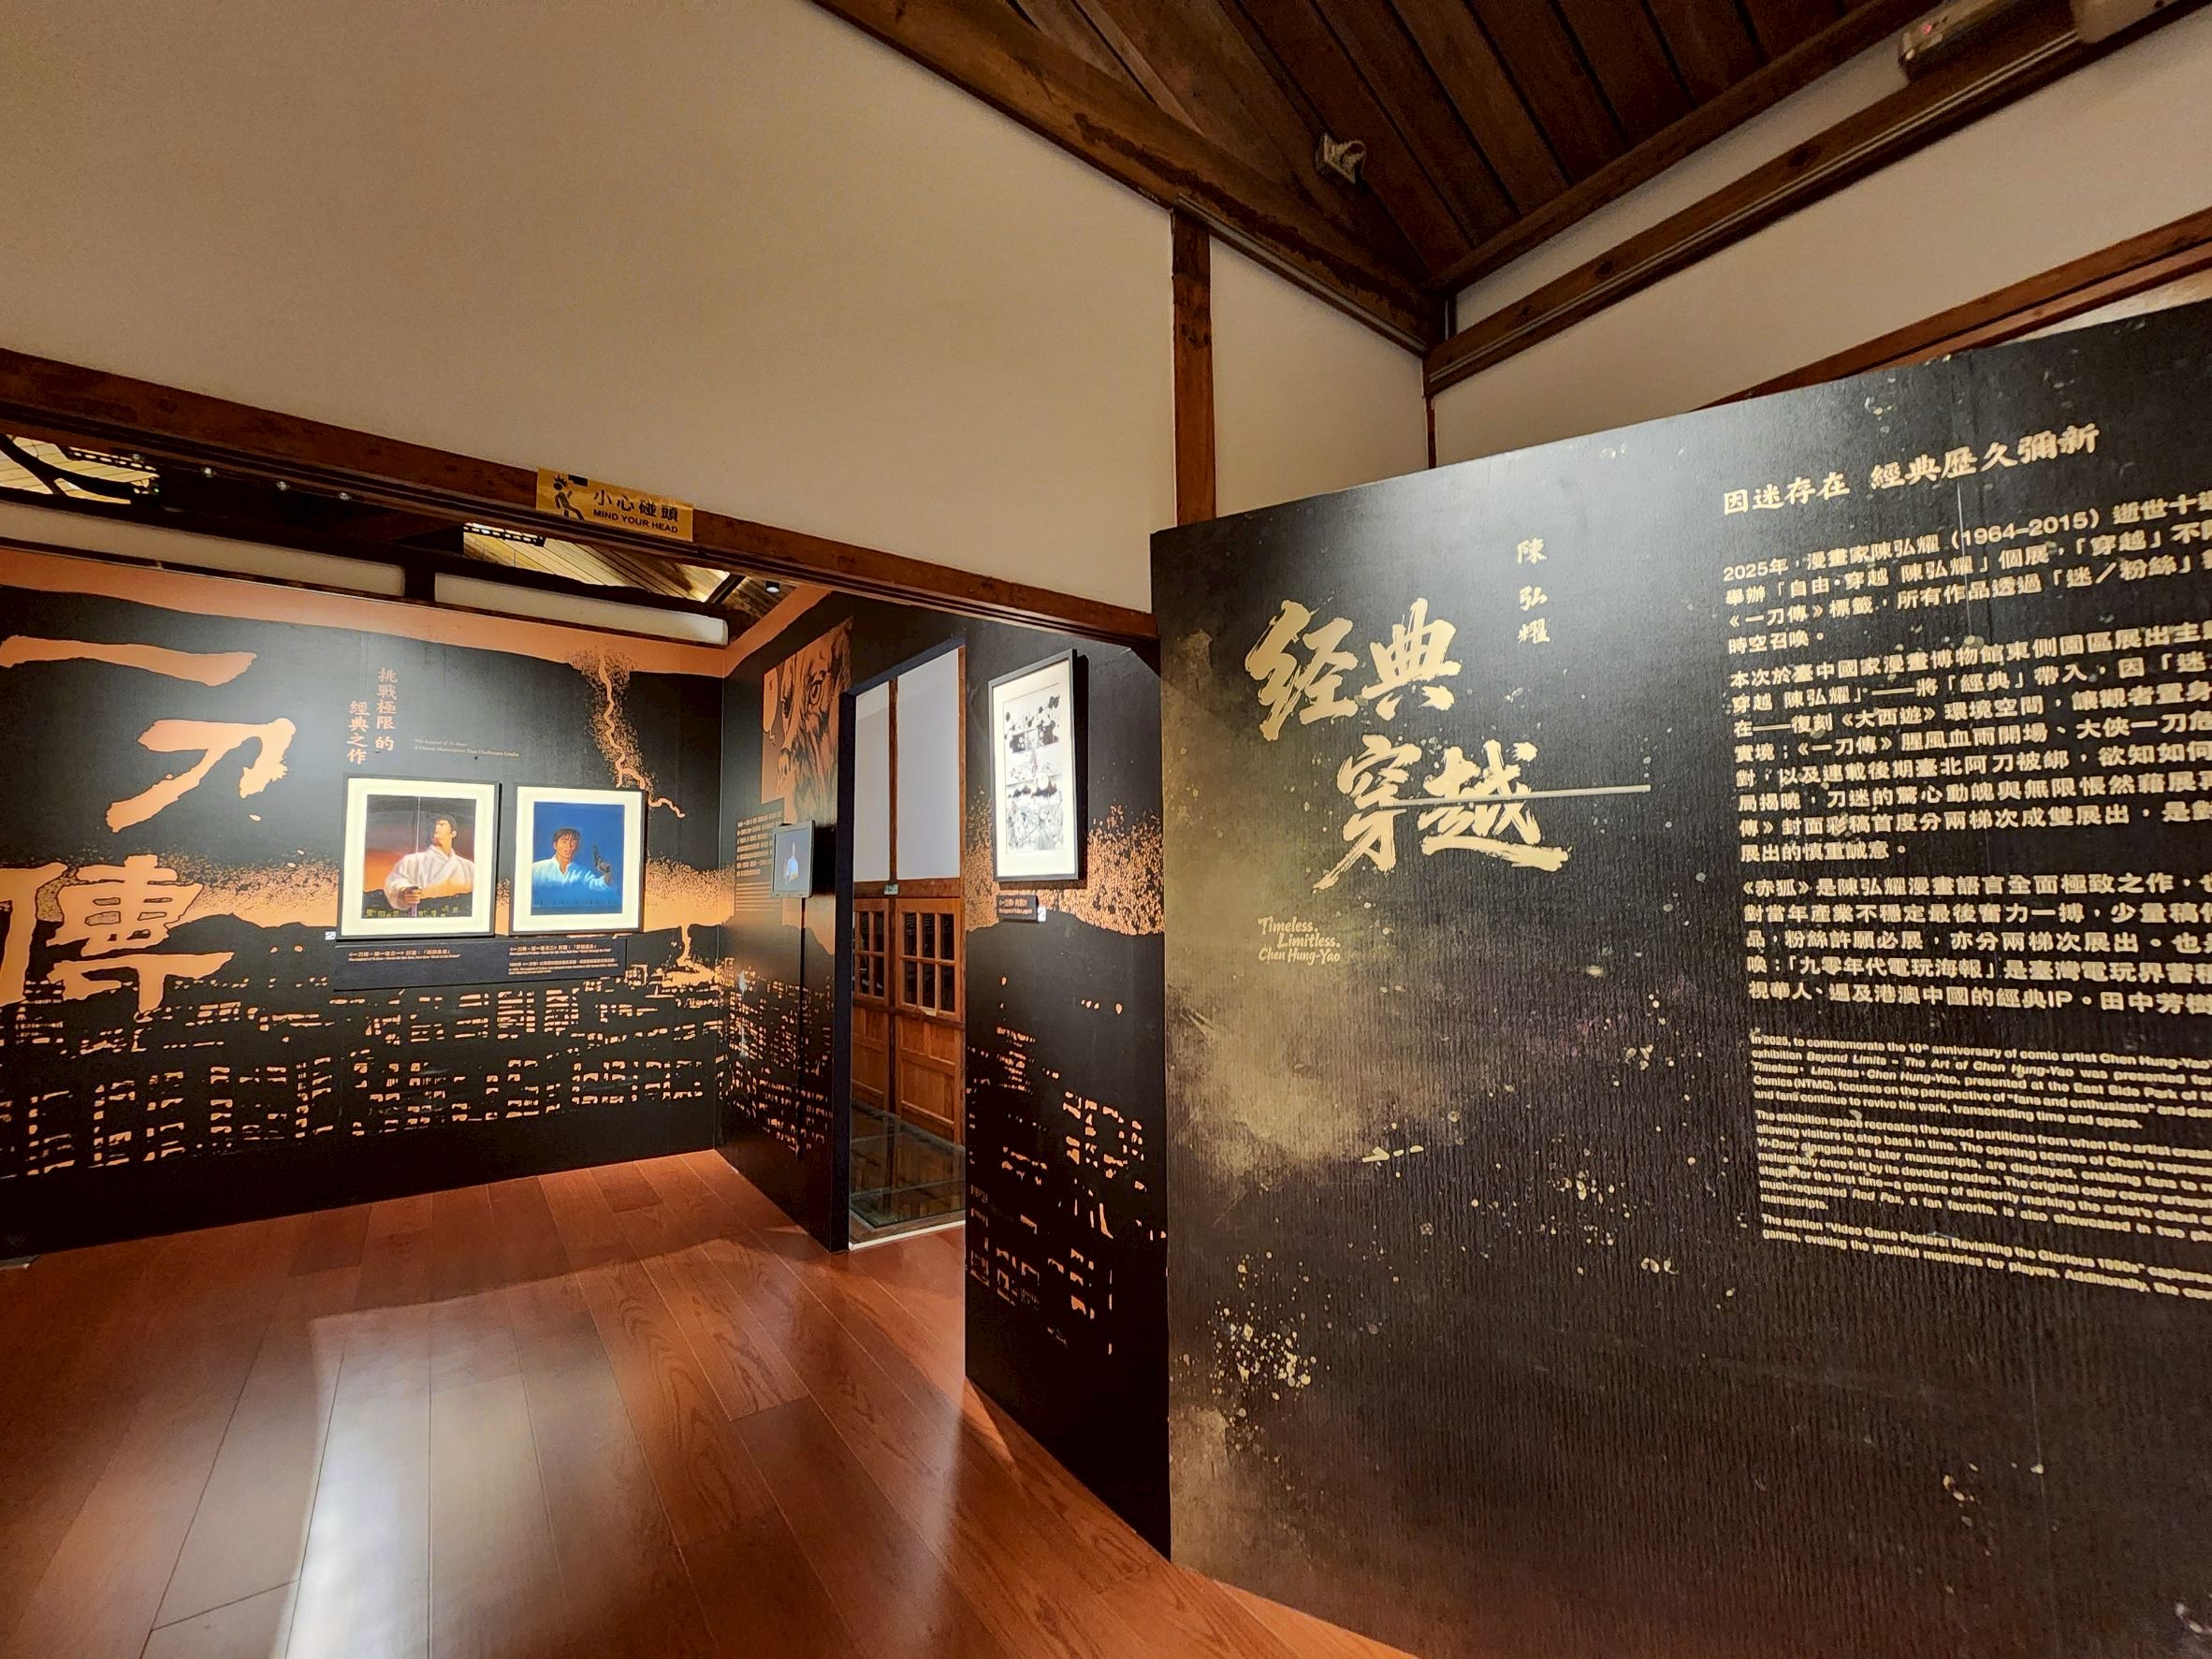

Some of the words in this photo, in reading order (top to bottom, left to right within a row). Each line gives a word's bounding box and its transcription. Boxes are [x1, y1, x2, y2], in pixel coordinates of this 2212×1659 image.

[1723, 471, 1851, 516] 因迷存在
[1870, 423, 2100, 490] 經典歷久彌新
[592, 508, 619, 521] MIND
[620, 515, 649, 527] YOUR
[651, 521, 678, 533] HEAD
[593, 488, 678, 522] 小心碰頭
[346, 700, 371, 764] 經典之作
[1313, 734, 1570, 893] 穿越
[1258, 944, 1286, 964] Chen
[1287, 947, 1341, 966] Hung-Yao
[1751, 1049, 1801, 1059] exhibition
[1806, 1051, 1847, 1063] Beyond
[1852, 1054, 1886, 1065] Limits
[1904, 1056, 1925, 1068] The
[1930, 1058, 1949, 1069] Art
[1955, 1060, 1968, 1070] of
[1972, 1060, 2005, 1071] Chen
[1761, 1035, 1791, 1046] 2025,
[1793, 1037, 1804, 1046] to
[1806, 1039, 1885, 1051] commemorate
[1886, 1041, 1905, 1052] the
[1931, 1045, 2001, 1058] anniversary
[2003, 1048, 2016, 1057] of
[2019, 1051, 2059, 1060] comic
[1753, 1075, 1792, 1086] Comics
[1794, 1078, 1836, 1091] (NTMC),
[1838, 1081, 1882, 1093] focuses
[1883, 1085, 1898, 1094] on
[1899, 1085, 1918, 1098] the
[1920, 1088, 1990, 1100] perspective
[1992, 1092, 2004, 1101] of
[1867, 1069, 1896, 1080] Chen
[1899, 1070, 1959, 1084] Hung-Yao,
[1964, 1076, 2027, 1088] presented
[2030, 1081, 2044, 1089] at
[1754, 1090, 1773, 1099] and
[1775, 1090, 1798, 1100] fans
[1799, 1094, 1847, 1104] continue
[1849, 1097, 1860, 1106] to
[1862, 1099, 1896, 1108] revive
[1899, 1099, 1915, 1110] his
[1918, 1102, 1950, 1113] work,
[1953, 1104, 2033, 1121] transcending
[1754, 1109, 1774, 1120] The
[1776, 1113, 1827, 1125] exhibition
[1829, 1116, 1862, 1128] space
[1864, 1121, 1917, 1134] recreates
[1919, 1124, 1939, 1134] the
[1941, 1128, 1973, 1137] wood
[1975, 1129, 2035, 1143] partitions
[1755, 1124, 1798, 1138] allowing
[1801, 1128, 1841, 1140] visitors
[1842, 1131, 1855, 1143] to
[1856, 1133, 1881, 1145] step
[1884, 1135, 1912, 1146] back
[1914, 1138, 1925, 1147] in
[1928, 1139, 1957, 1151] time.
[1959, 1142, 1983, 1153] The
[1986, 1145, 2036, 1160] opening
[1756, 1152, 1817, 1167] melancholy
[1819, 1158, 1846, 1169] once
[1848, 1160, 1866, 1172] felt
[1869, 1162, 1883, 1174] by
[1885, 1164, 1899, 1174] its
[1900, 1166, 1948, 1179] devoted
[1950, 1171, 2001, 1185] readers.
[2003, 1175, 2028, 1188] The
[1800, 1142, 1853, 1155] alongside
[1855, 1147, 1871, 1157] its
[1874, 1148, 1900, 1159] later
[1904, 1153, 1981, 1169] manuscripts,
[1986, 1160, 2005, 1171] are
[1759, 1180, 1846, 1197] much-requested
[1852, 1188, 1874, 1201] Red
[1880, 1192, 1903, 1204] Fox,
[1909, 1197, 1917, 1205] a
[1922, 1197, 1942, 1208] fan
[1945, 1200, 1997, 1215] favorite,
[2002, 1206, 2014, 1216] is
[2019, 1209, 2047, 1221] also
[1760, 1194, 1828, 1210] manuscripts.
[1813, 1171, 1831, 1181] the
[1832, 1172, 1855, 1184] first
[1903, 1182, 1948, 1194] gesture
[1950, 1186, 1963, 1195] of
[1965, 1187, 2018, 1203] sincerity
[1762, 1213, 1781, 1225] The
[1783, 1217, 1823, 1230] section
[1864, 1227, 1898, 1240] Game
[1951, 1237, 2012, 1257] Revisiting
[2014, 1246, 2035, 1259] the
[1762, 1229, 1800, 1243] games,
[1804, 1234, 1846, 1249] evoking
[1850, 1239, 1869, 1251] the
[1872, 1244, 1919, 1258] youthful
[1923, 1250, 1983, 1266] memories
[1986, 1258, 2004, 1269] for
[2008, 1261, 2059, 1277] players.
